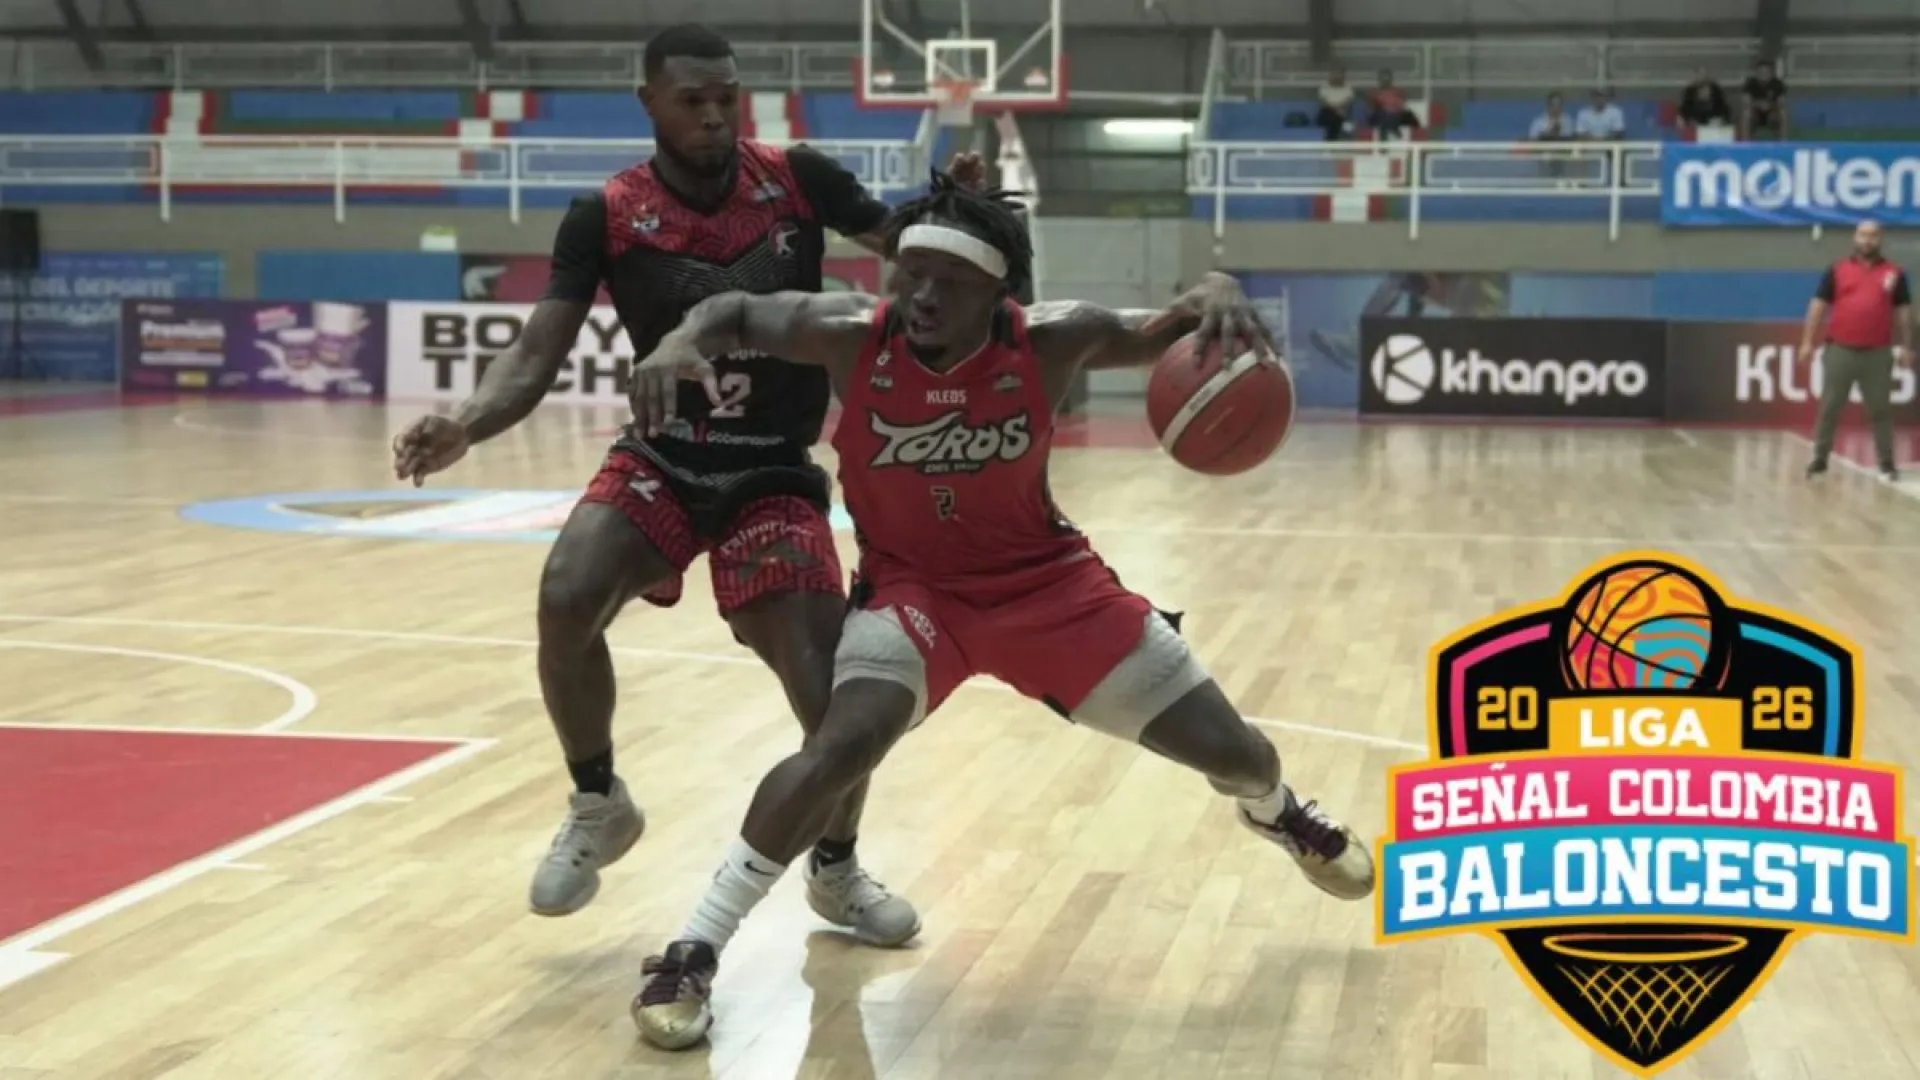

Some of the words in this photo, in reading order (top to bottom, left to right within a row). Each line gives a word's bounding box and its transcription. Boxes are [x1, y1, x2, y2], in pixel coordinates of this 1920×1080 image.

[1674, 149, 1920, 210] molten
[422, 311, 625, 352] BOY
[1440, 349, 1647, 404] khanpro
[1736, 344, 1916, 404] KLS
[869, 410, 1031, 467] TOROS
